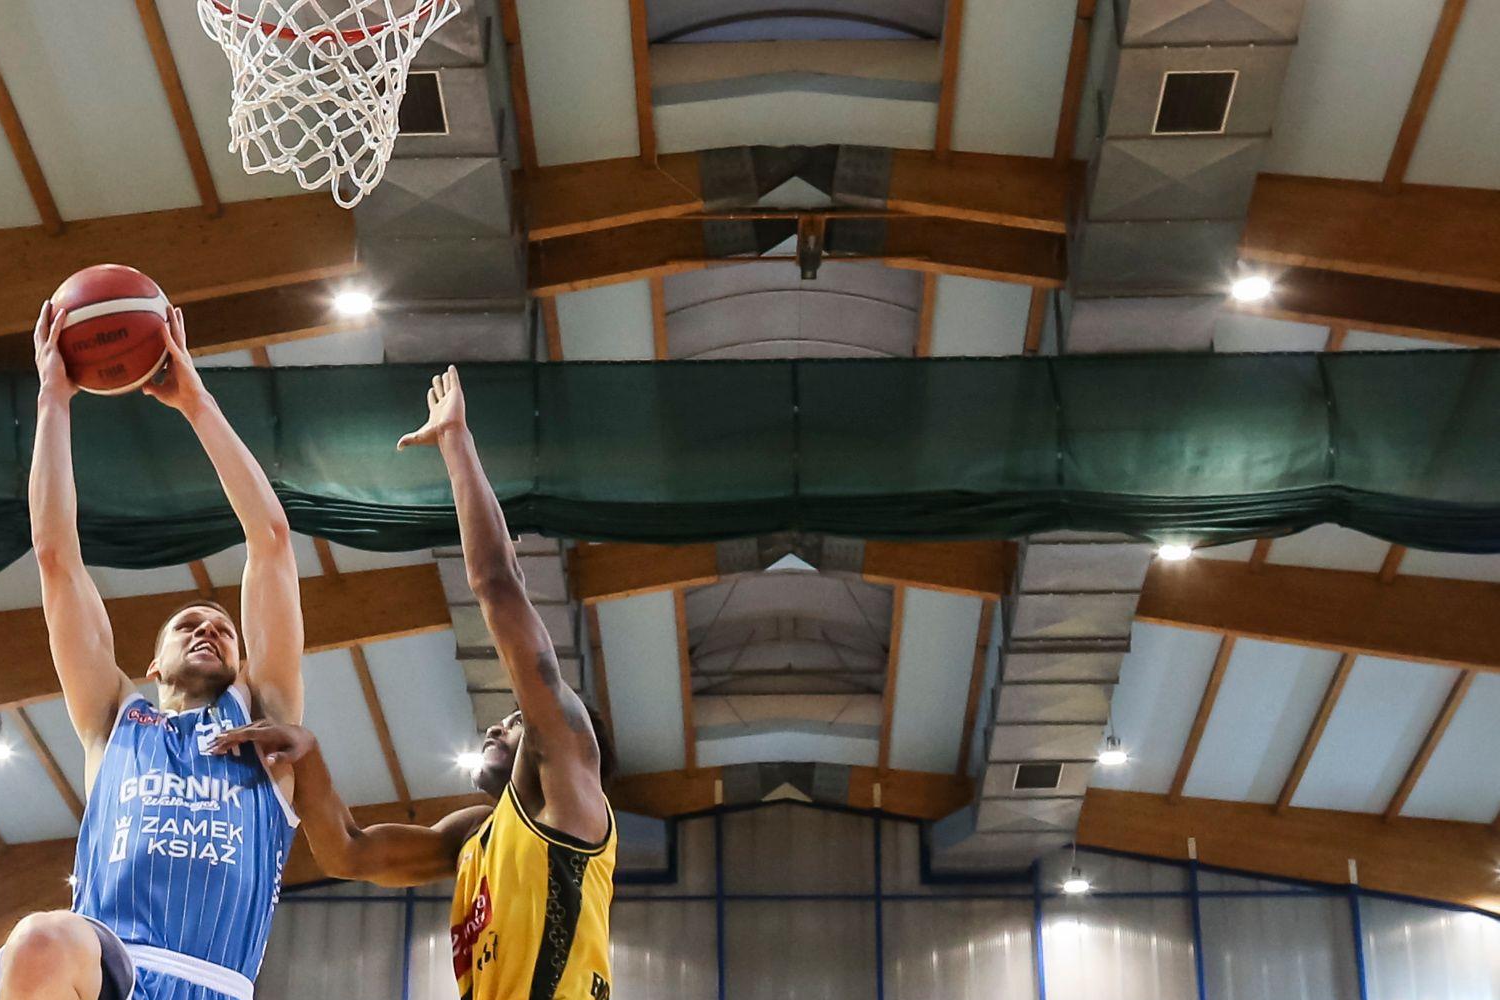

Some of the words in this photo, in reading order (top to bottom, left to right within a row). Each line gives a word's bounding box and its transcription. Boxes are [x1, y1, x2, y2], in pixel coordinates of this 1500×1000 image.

[120, 768, 243, 808] GÓRNIK
[141, 816, 244, 844] ZAMEK
[147, 837, 237, 866] KSIĄŻ
